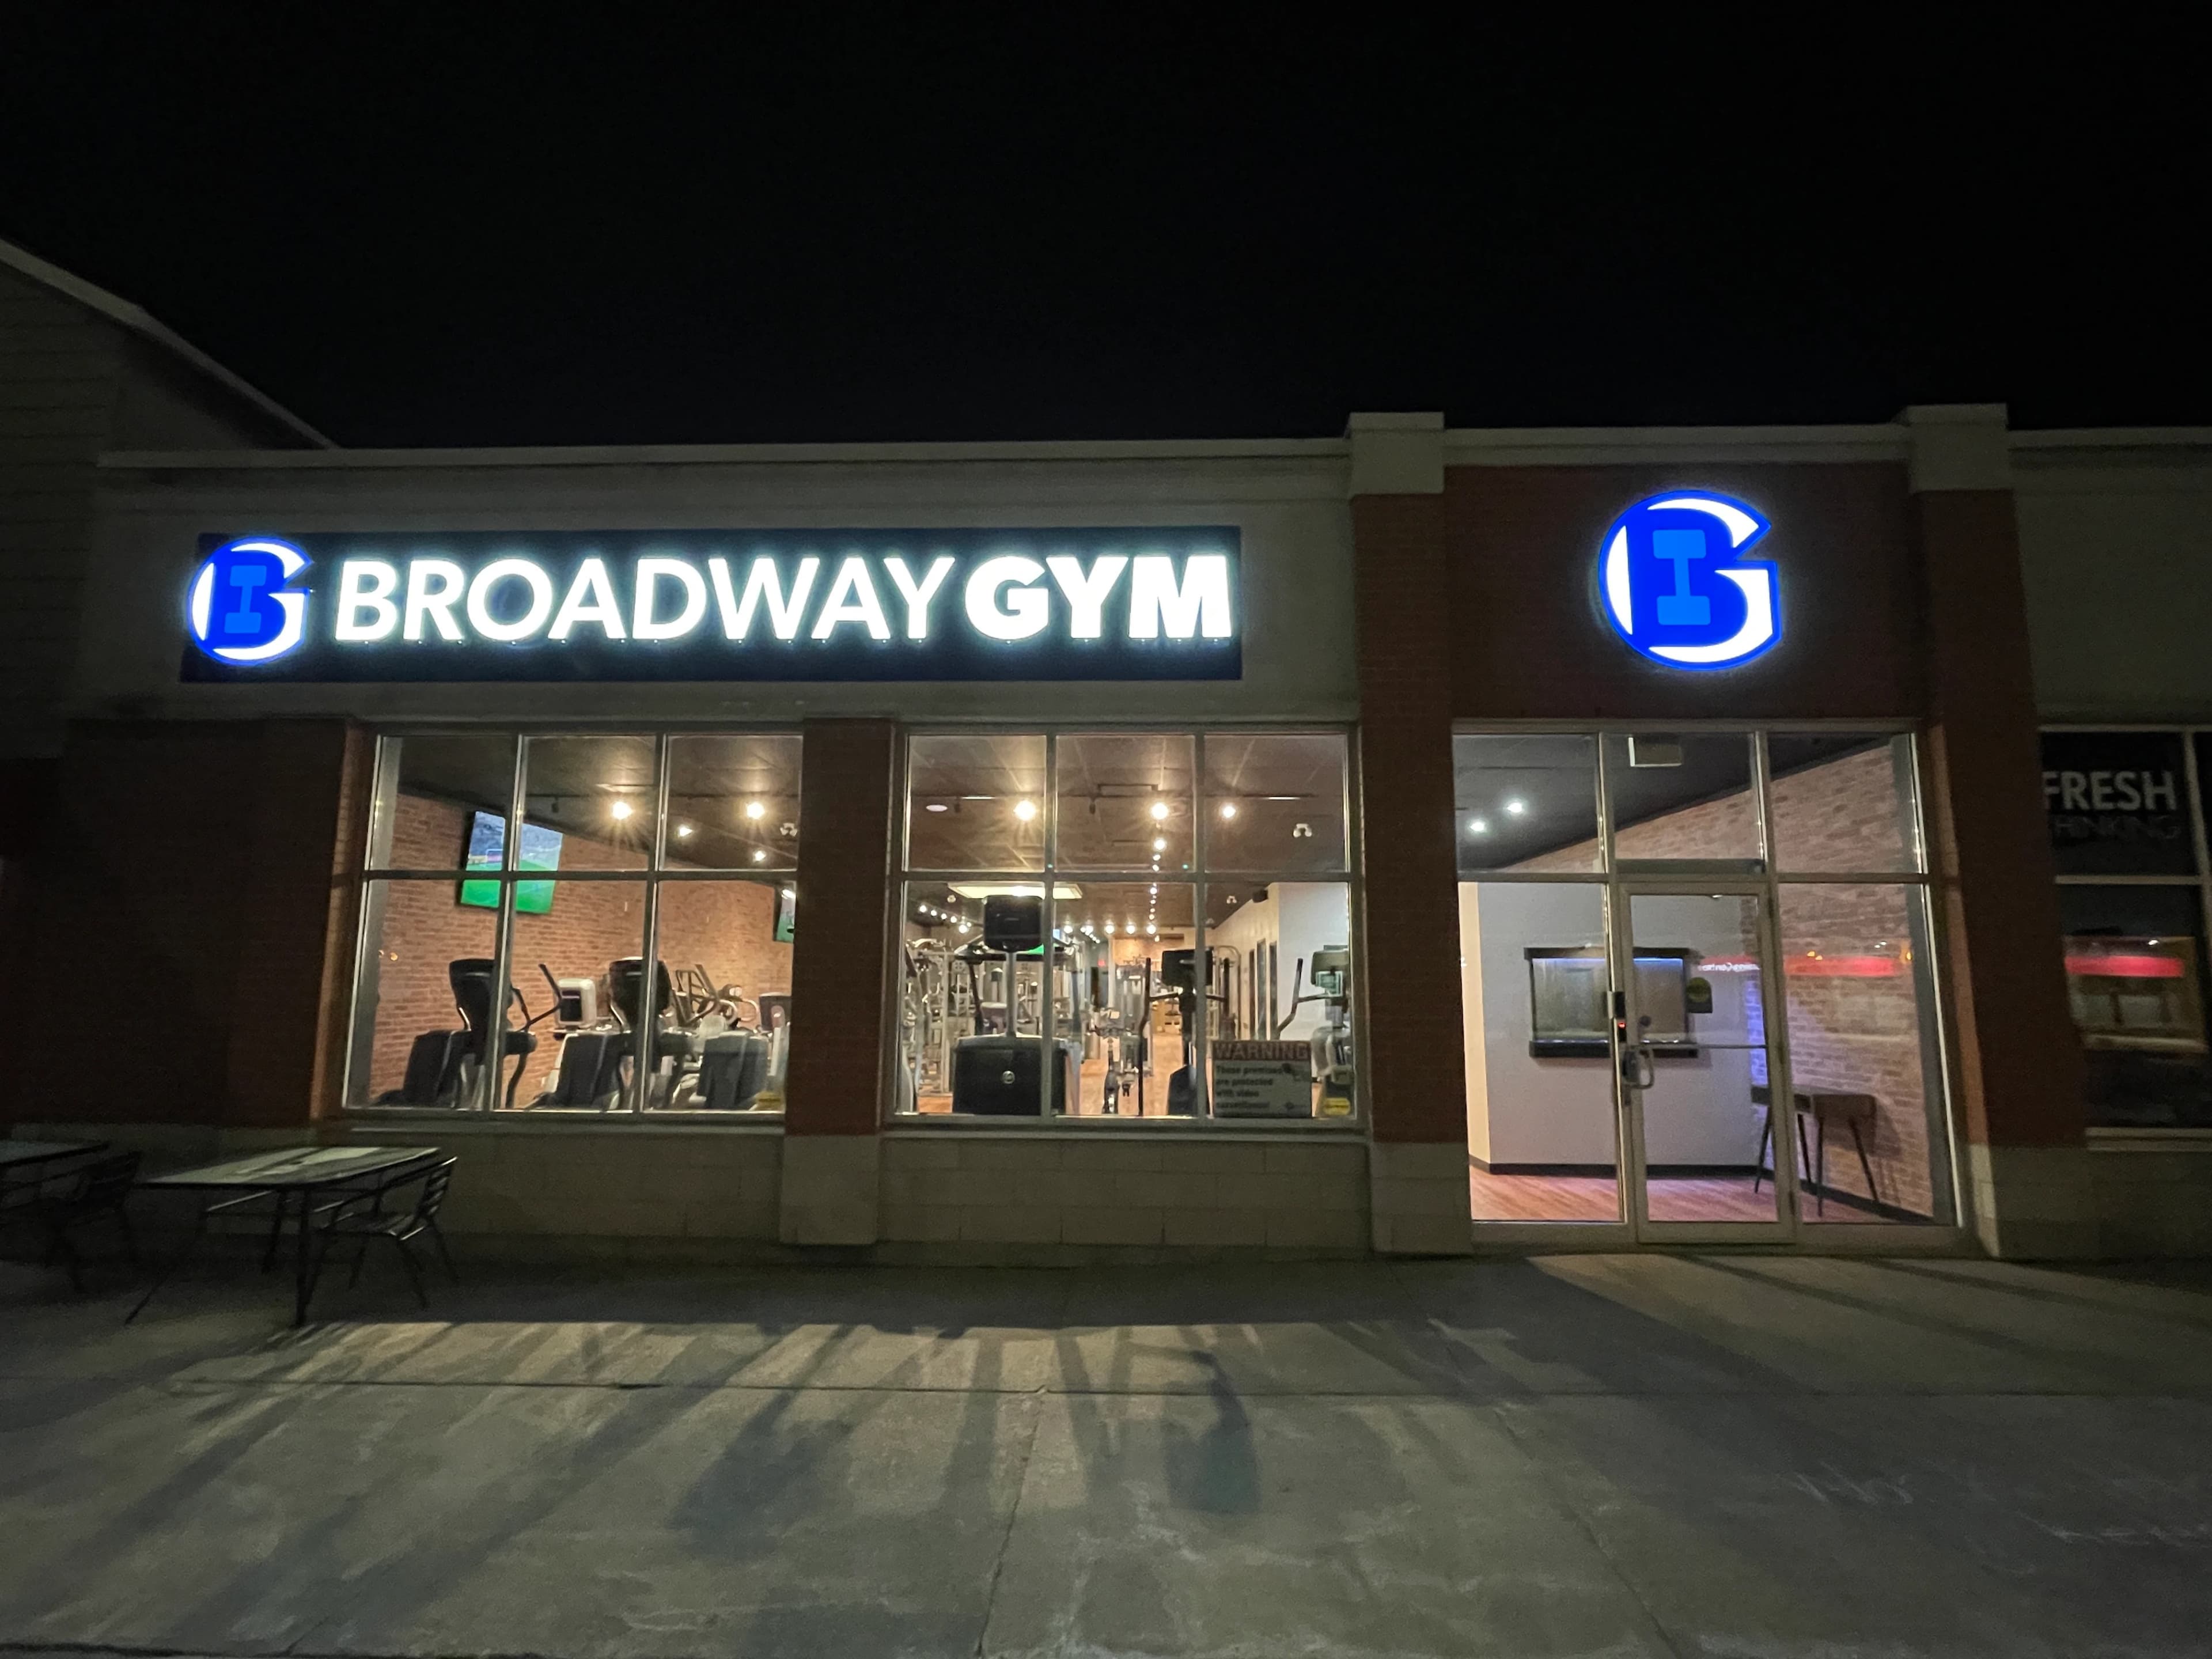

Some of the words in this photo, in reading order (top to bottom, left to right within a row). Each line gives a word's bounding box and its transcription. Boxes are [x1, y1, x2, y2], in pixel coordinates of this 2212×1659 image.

[335, 556, 955, 642] BROADWAY
[965, 556, 1232, 641] GYM
[2041, 771, 2176, 810] FRESH
[1215, 1043, 1308, 1059] WARNING
